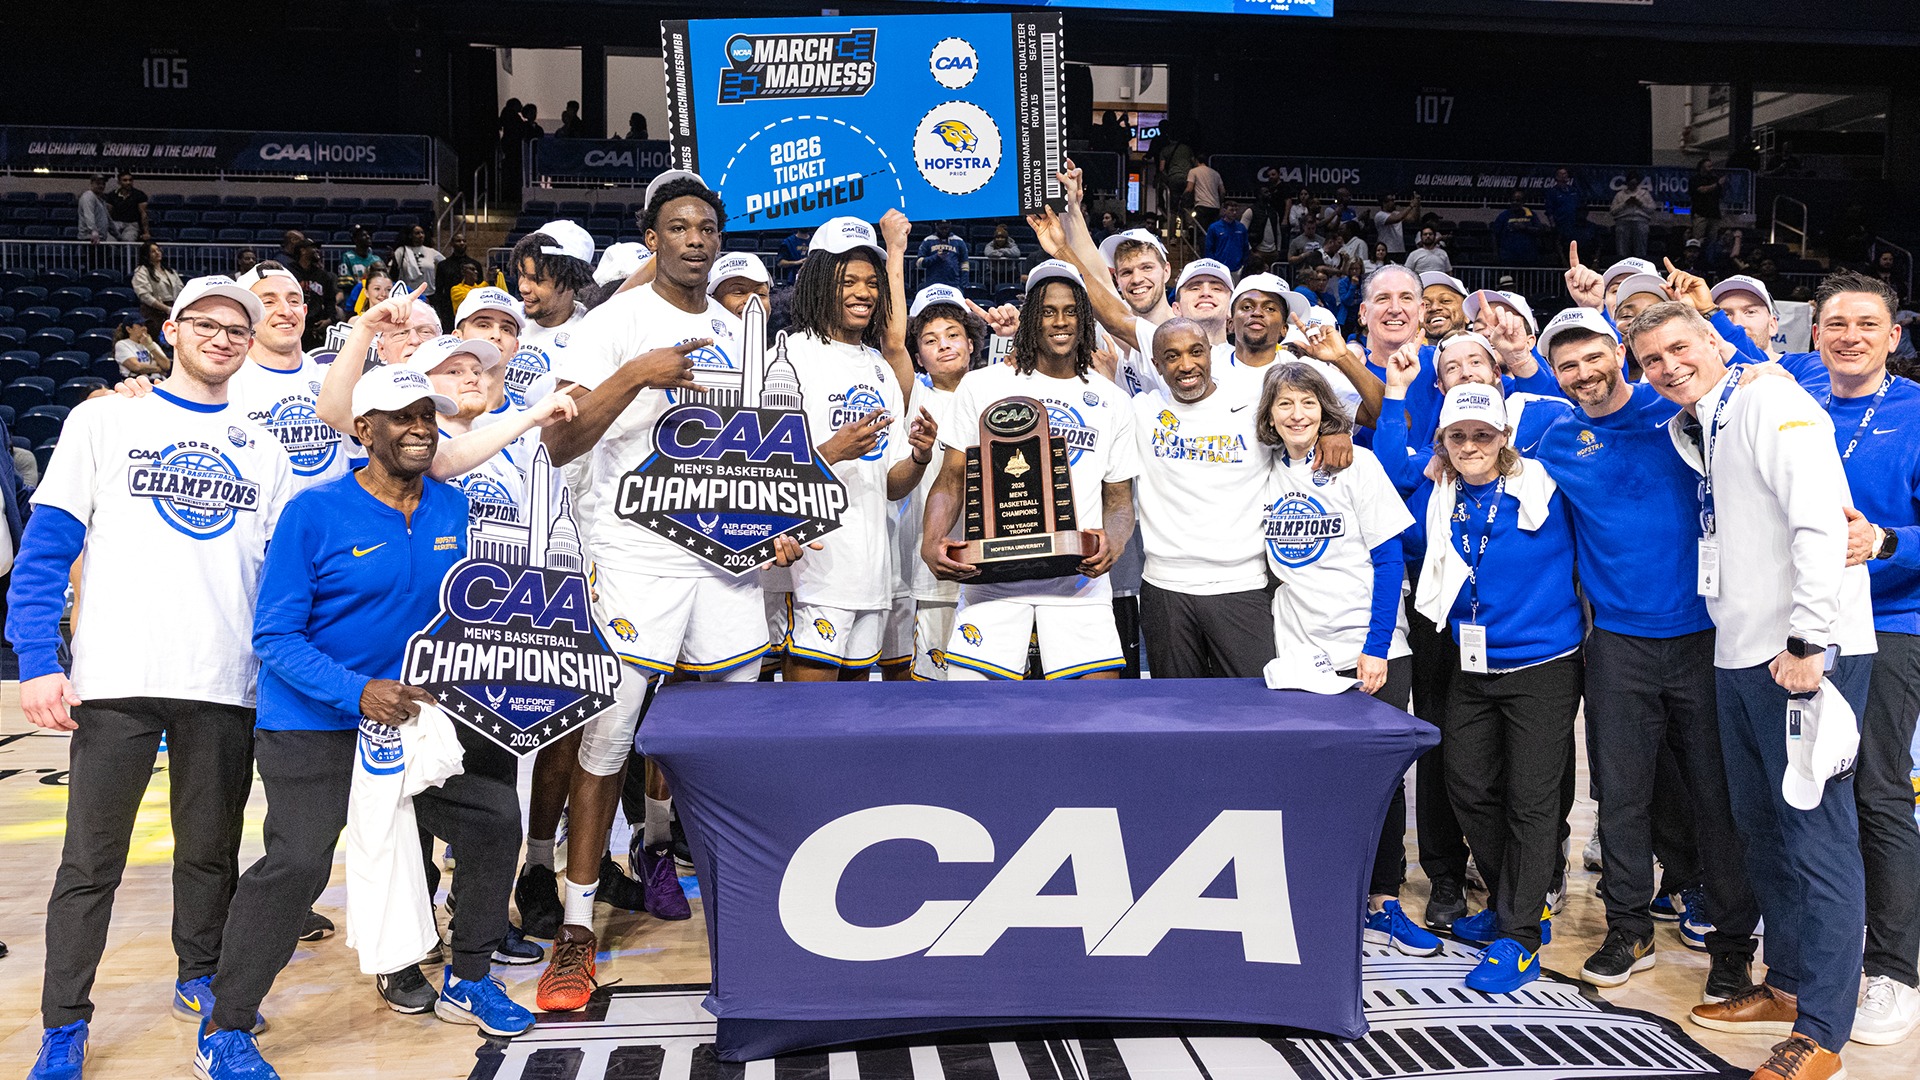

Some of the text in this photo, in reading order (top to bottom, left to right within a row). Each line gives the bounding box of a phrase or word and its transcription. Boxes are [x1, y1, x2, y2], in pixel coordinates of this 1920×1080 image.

[754, 38, 834, 64] MARCH
[1017, 23, 1028, 70] QUALIFIER
[1028, 24, 1038, 61] SEAT 26
[936, 56, 972, 70] CAA
[142, 58, 188, 88] 105
[765, 62, 872, 88] MADNESS
[672, 33, 690, 136] @MARCHMADNESSMBB
[1019, 71, 1029, 125] AUTOMATIC
[1030, 94, 1040, 128] ROW 15
[1415, 96, 1454, 124] 107
[28, 142, 216, 158] CAA CHAMPION, CROWNED IN THE CAPITAL
[259, 143, 376, 162] CAA HOOPS
[584, 150, 634, 168] CAA
[770, 135, 822, 166] 2026
[1021, 126, 1030, 184] TOURNAMENT
[774, 158, 826, 185] TICKET
[924, 157, 992, 170] HOFSTRA
[1309, 168, 1360, 184] HOOPS
[1414, 174, 1543, 188] CAA CHAMPION, CROWNED IN THE
[1034, 168, 1042, 208] SECTION
[746, 172, 864, 224] PUNCHED
[1562, 312, 1584, 322] CHAMPS
[1727, 368, 1742, 388] CAA
[1876, 379, 1891, 397] CAA
[281, 395, 310, 404] 2026
[828, 393, 846, 402] CAA
[1039, 398, 1070, 408] 2026
[1470, 396, 1490, 406] CHAMPS
[248, 411, 272, 420] CAA
[991, 408, 1032, 424] CAA
[1714, 400, 1726, 422] CAA
[1860, 408, 1875, 428] CAA
[656, 406, 813, 465] CAA
[1151, 428, 1248, 450] HOFSTRA
[128, 449, 162, 460] CAA
[178, 441, 220, 454] 2026
[1154, 445, 1243, 463] BASKETBALL
[1576, 442, 1604, 457] HOFSTRA
[1842, 440, 1858, 458] CAA
[162, 466, 236, 482] MEN'S BASKETBALL
[674, 463, 798, 478] MEN'S BASKETBALL
[132, 469, 257, 506] CHAMPIONS
[1496, 475, 1505, 493] CAA
[618, 475, 846, 521] CHAMPIONSHIP
[1009, 490, 1028, 498] MEN'S
[999, 499, 1040, 509] BASKETBALL
[1002, 508, 1038, 518] CHAMPIONS
[1458, 502, 1466, 522] CAA
[186, 515, 210, 523] MARCH
[1486, 504, 1498, 523] CAA
[722, 522, 772, 531] AIR FORCE
[724, 528, 769, 537] RESERVE
[1002, 521, 1038, 530] TOM YEAGER
[990, 542, 1045, 552] HOFSTRA UNIVERSITY
[1462, 534, 1471, 554] CAA
[1478, 535, 1489, 554] CAA
[724, 554, 756, 566] 2026
[448, 562, 591, 634] CAA
[464, 627, 578, 648] MEN'S BASKETBALL
[408, 638, 620, 696] CHAMPIONSHIP
[510, 704, 552, 713] RESERVE
[530, 698, 556, 706] FORCE
[510, 733, 540, 748] 2026
[778, 804, 1301, 965] CAA
